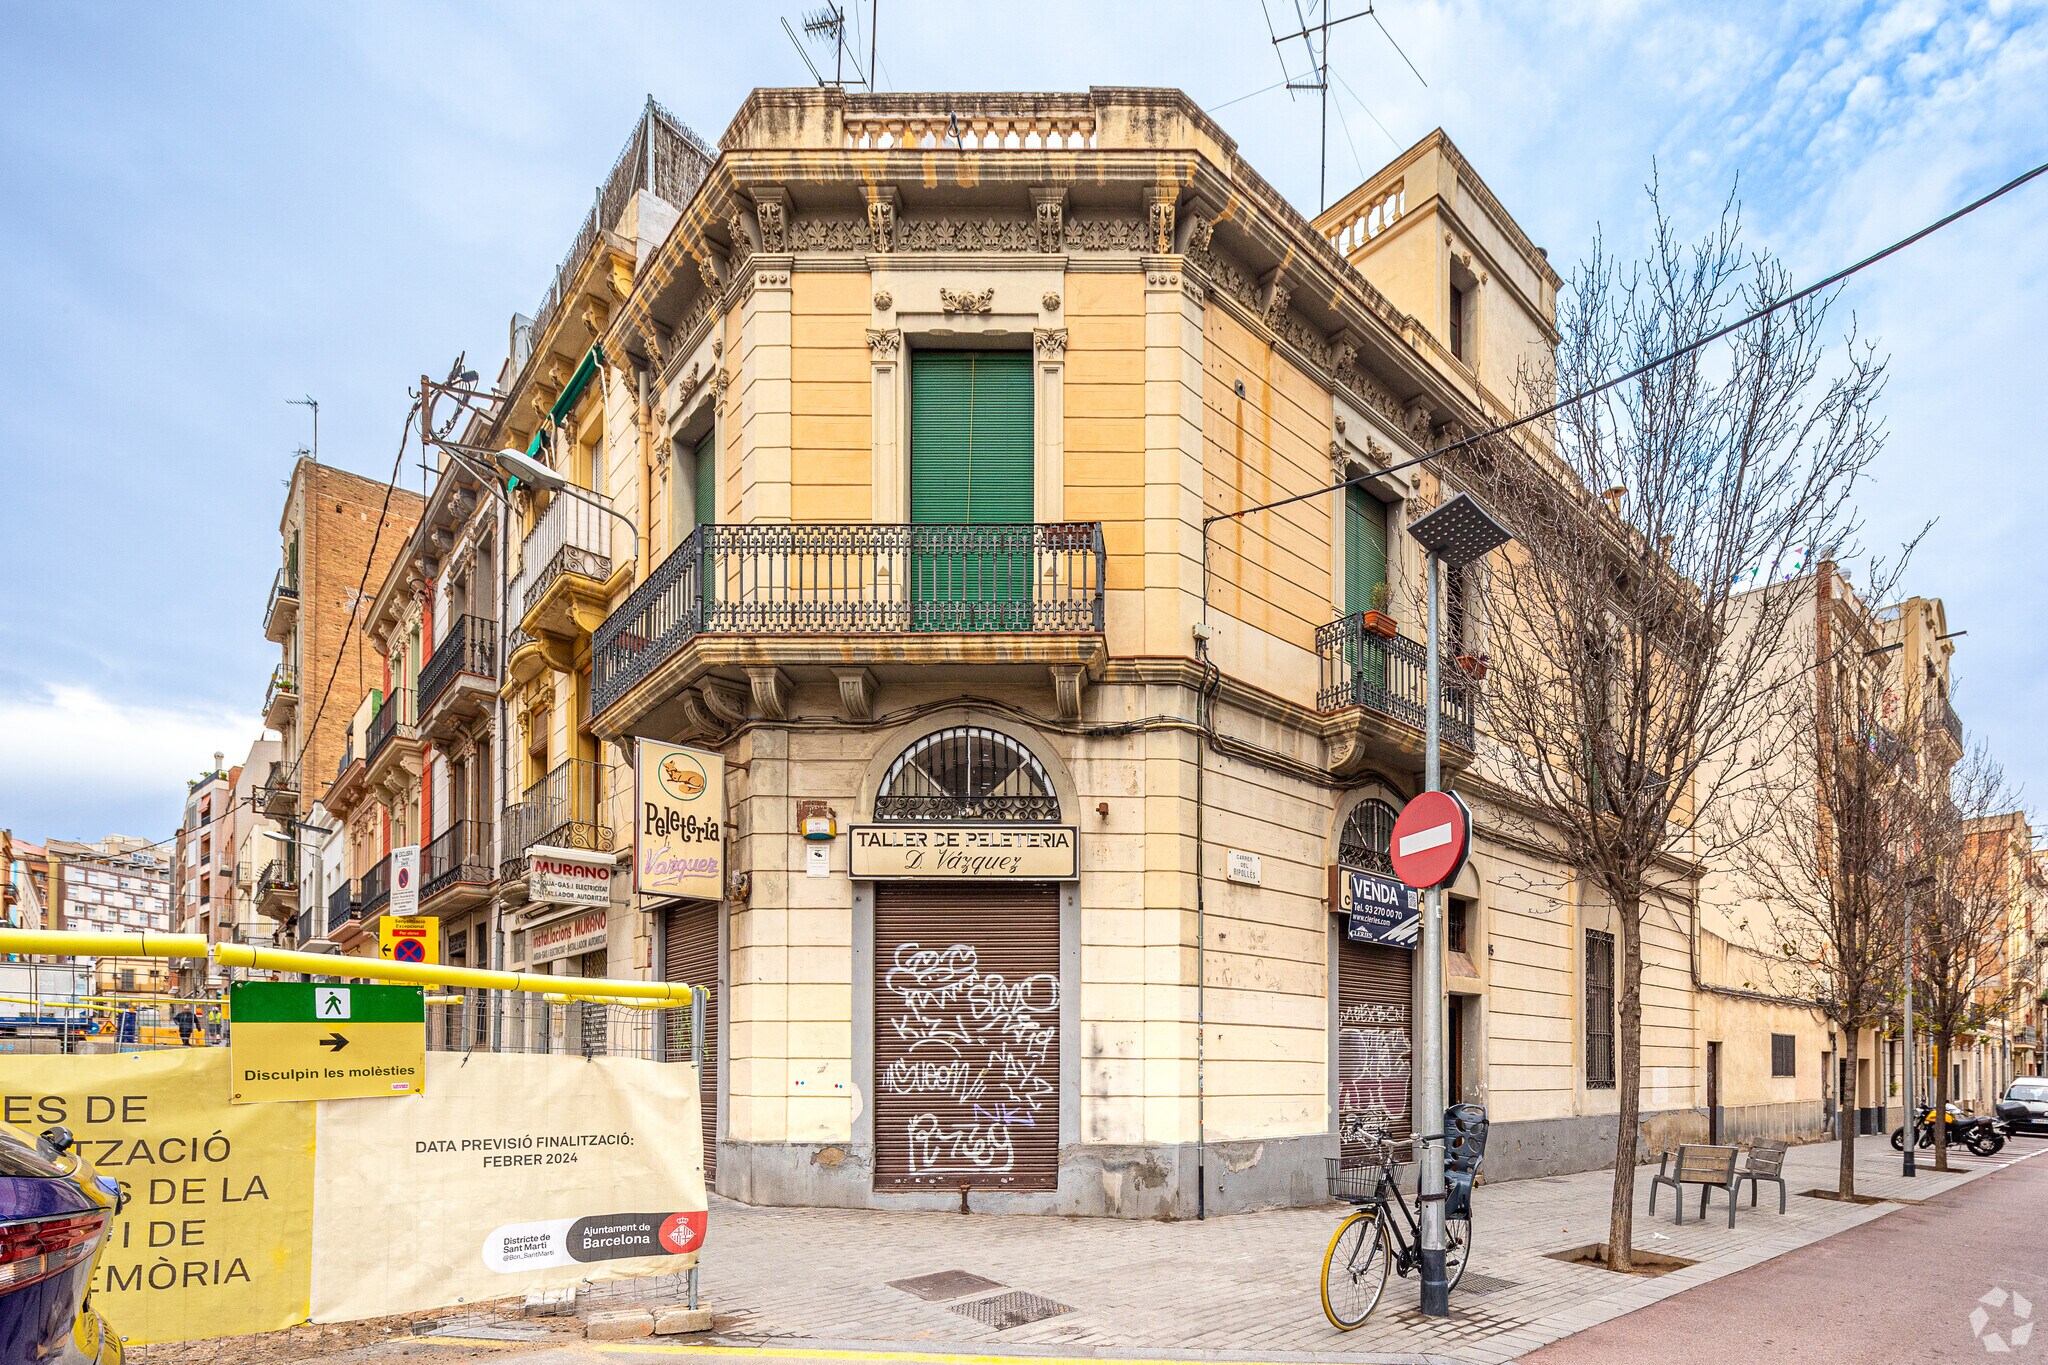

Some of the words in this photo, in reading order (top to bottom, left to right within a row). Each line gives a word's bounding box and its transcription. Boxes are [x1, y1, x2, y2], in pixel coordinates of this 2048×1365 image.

[644, 801, 720, 843] Peletería
[856, 832, 928, 848] TALLER
[934, 832, 960, 848] DE
[965, 832, 1070, 848] PELETERIA
[904, 850, 923, 870] D.
[937, 849, 1022, 874] Vázquez
[1236, 854, 1253, 862] CARRER
[535, 860, 609, 880] MURANO
[1353, 877, 1399, 906] VENDA
[1352, 913, 1391, 926] www.cleries.com
[1353, 902, 1364, 912] Tel.
[1364, 904, 1373, 914] 93
[1373, 906, 1385, 917] 270
[1385, 908, 1395, 918] 00
[1395, 911, 1403, 920] 70
[574, 911, 607, 937] MURANO
[244, 1069, 319, 1082] Disculpin
[324, 1067, 344, 1078] les
[349, 1065, 415, 1078] molèsties
[87, 1095, 148, 1124] DE
[415, 1140, 457, 1153] DATA
[461, 1135, 533, 1151] PREVISIÓ
[536, 1132, 634, 1148] FINALITZACIÓ:
[483, 1154, 543, 1168] FEBRER
[546, 1152, 578, 1165] 2024
[149, 1178, 207, 1205] DE
[222, 1175, 270, 1203] LA
[148, 1220, 206, 1248] DE
[583, 1223, 637, 1236] Ajuntament
[638, 1222, 651, 1231] de
[503, 1235, 539, 1246] Districte
[539, 1234, 551, 1242] de
[583, 1234, 651, 1249] Barcelona
[503, 1245, 523, 1254] Sant
